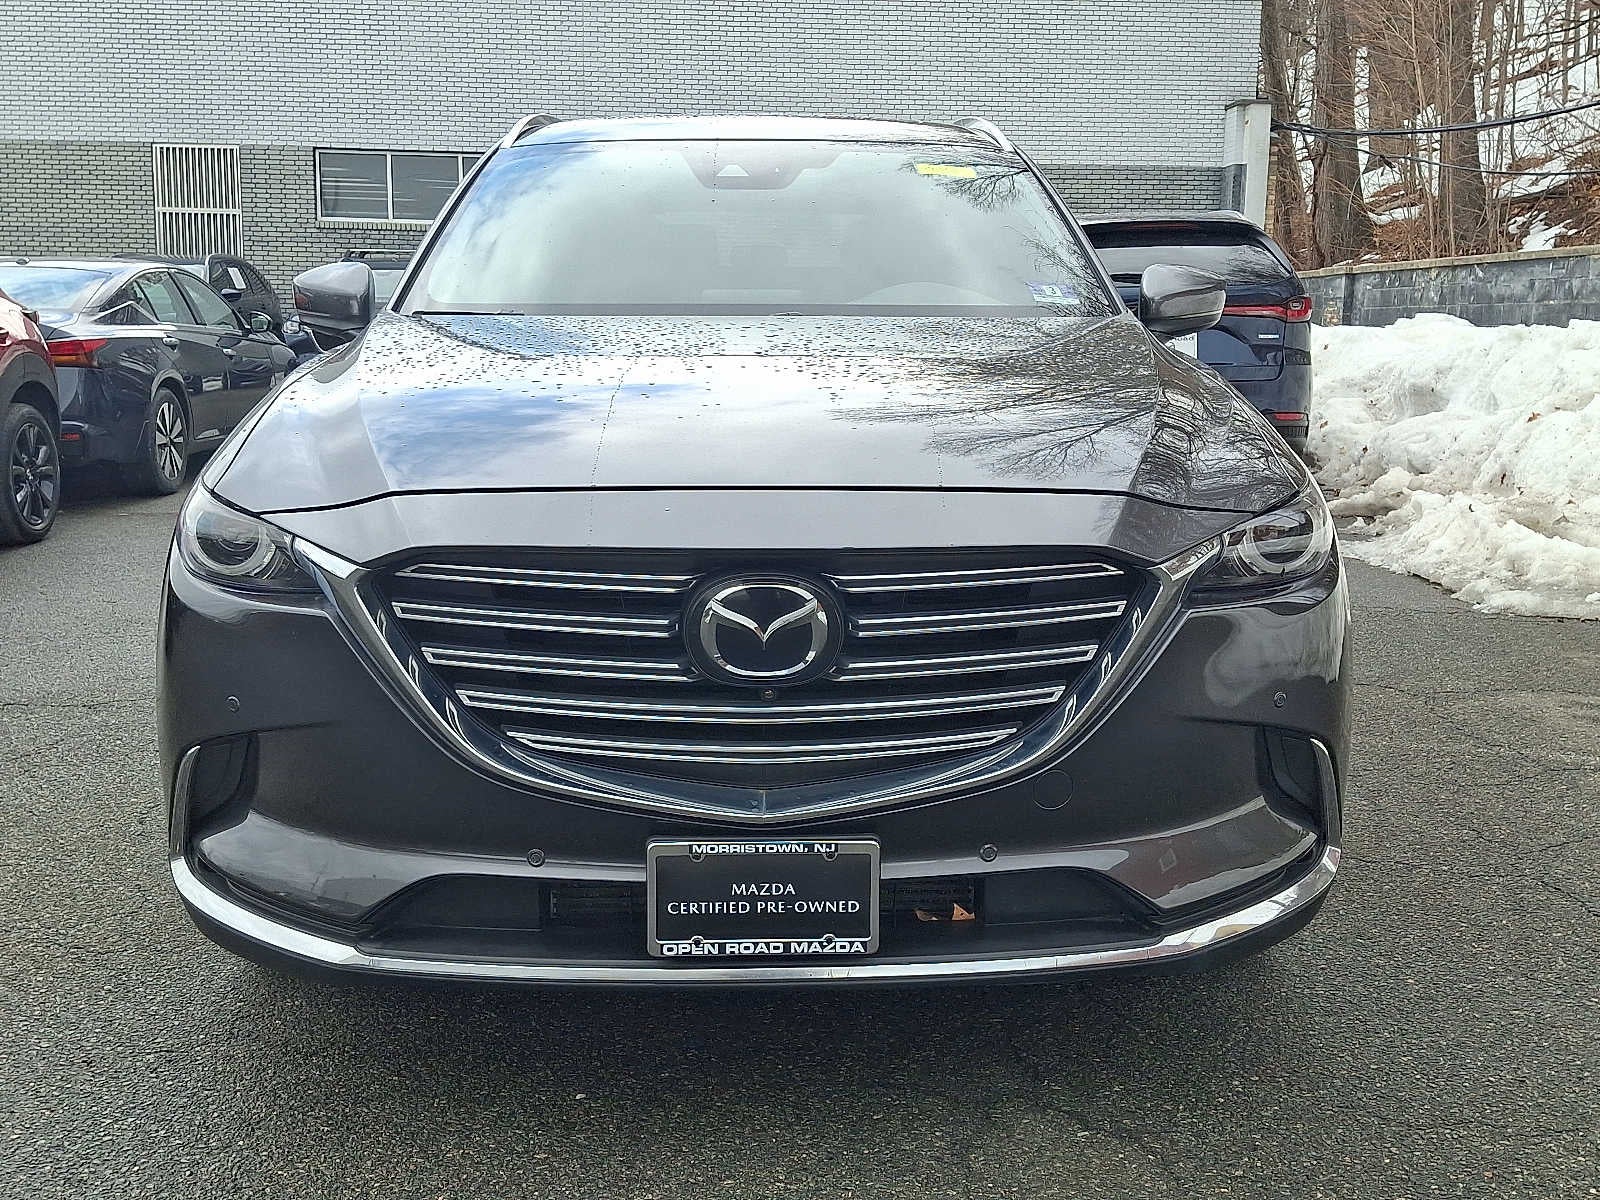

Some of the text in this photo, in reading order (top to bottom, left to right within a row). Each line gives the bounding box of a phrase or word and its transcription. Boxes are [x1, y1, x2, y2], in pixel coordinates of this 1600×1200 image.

[692, 844, 836, 854] MORRISTOWN, NJ
[731, 883, 796, 896] MAZDA
[667, 901, 860, 915] CERTIFIED PRE-OWNED
[662, 942, 865, 955] OPEN ROAD MAZDA
